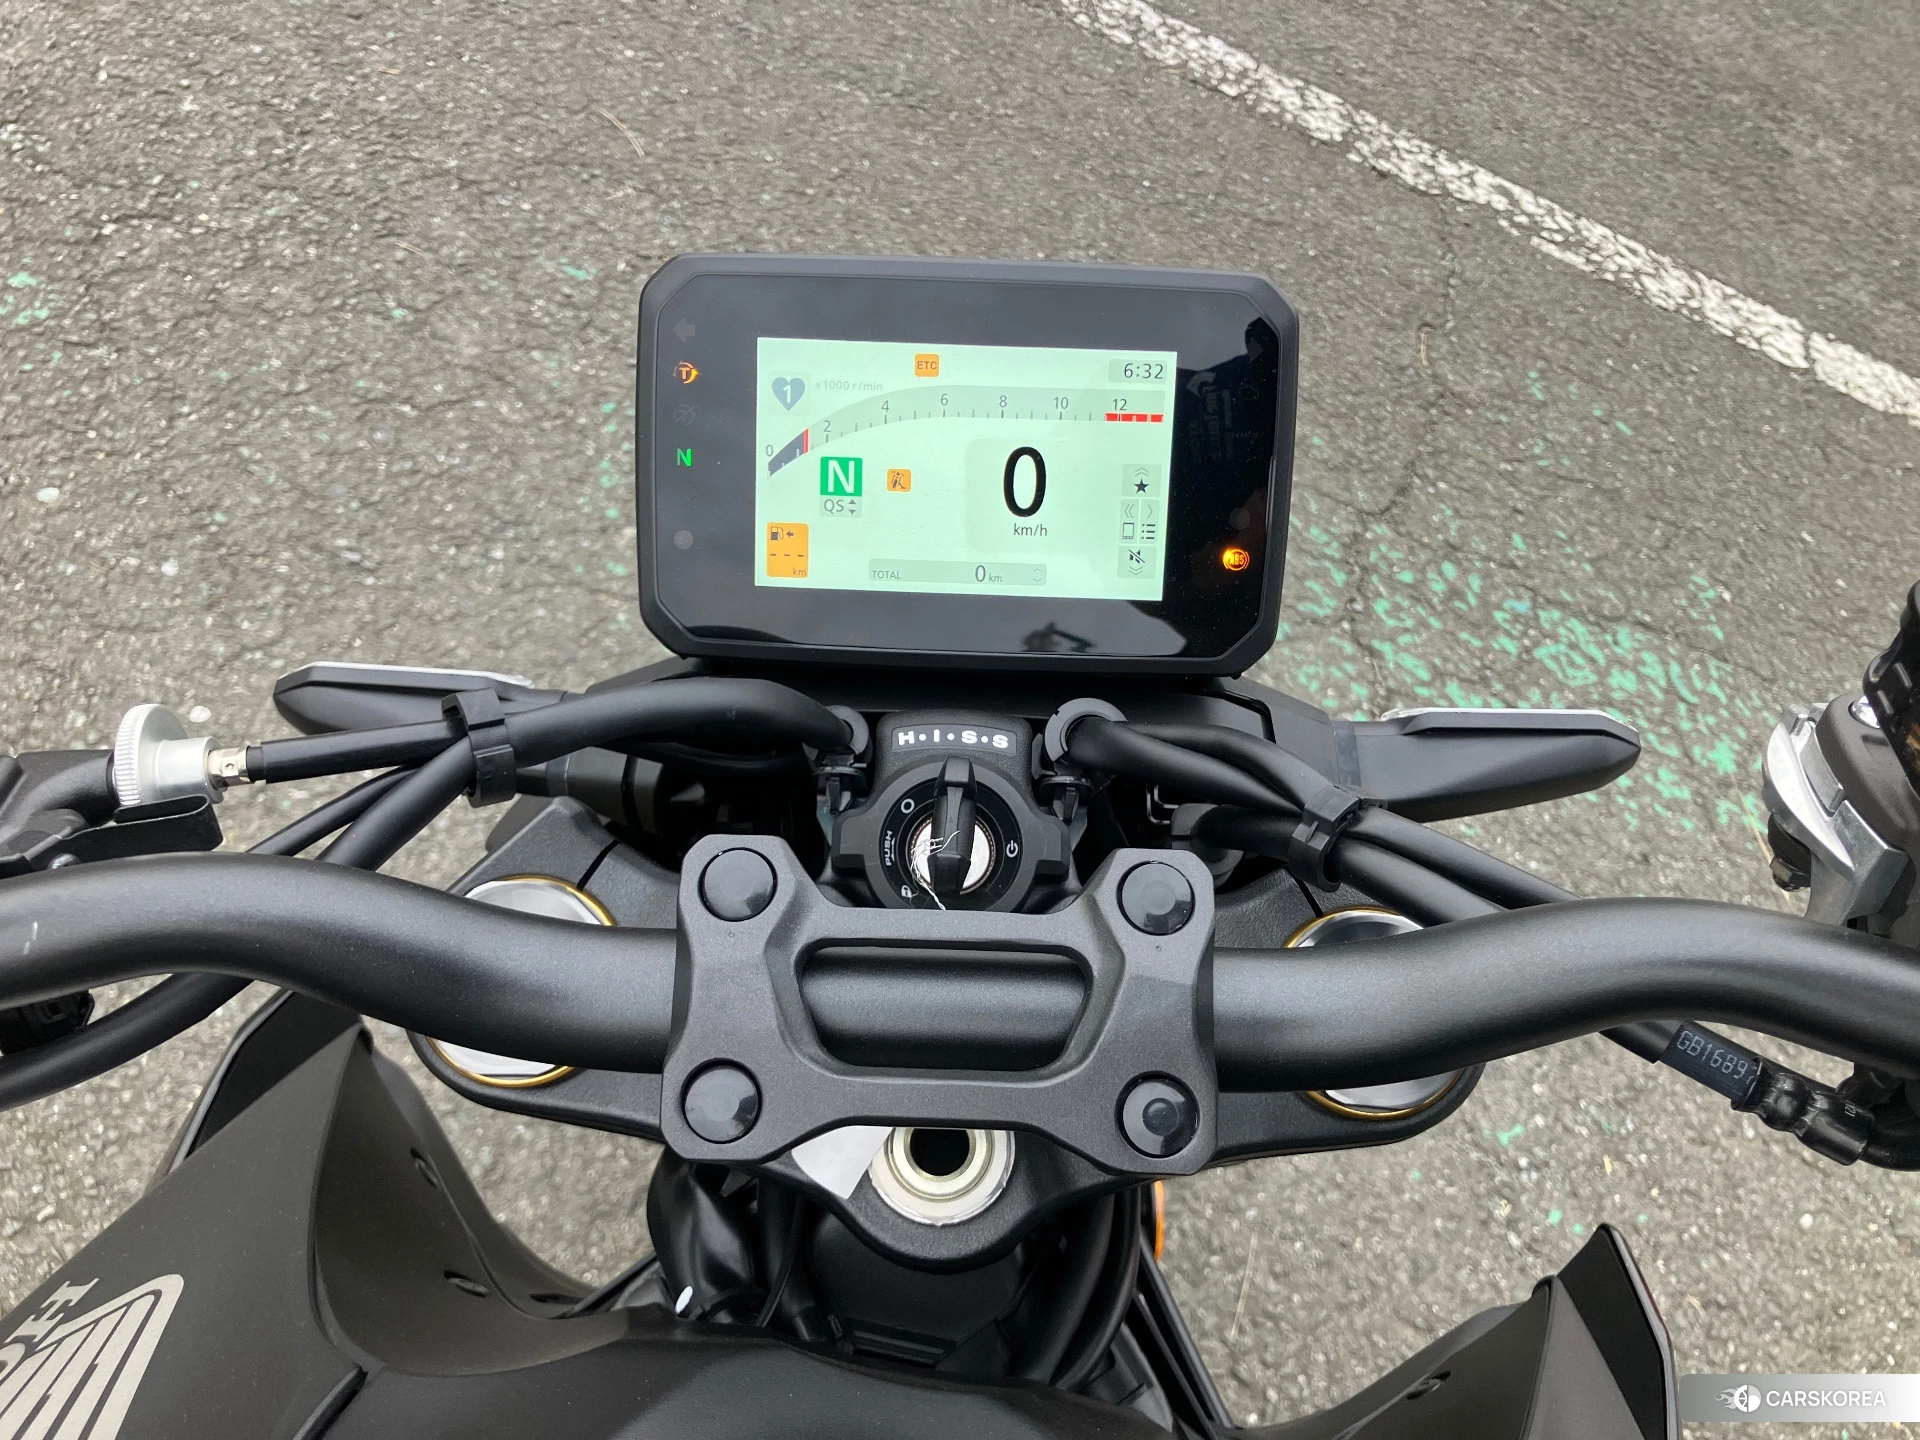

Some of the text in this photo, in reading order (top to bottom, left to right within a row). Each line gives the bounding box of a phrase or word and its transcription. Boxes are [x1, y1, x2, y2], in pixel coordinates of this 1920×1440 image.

[916, 360, 938, 370] ETC
[1123, 362, 1164, 380] 6:32
[852, 381, 883, 392] r/min
[782, 384, 792, 404] 1
[940, 393, 949, 406] 6
[881, 400, 890, 413] 4
[999, 395, 1008, 408] 8
[1053, 396, 1069, 410] 10
[1112, 398, 1127, 411] 12
[823, 419, 831, 433] 2
[676, 448, 692, 467] N
[765, 444, 774, 457] 0
[827, 459, 855, 494] N
[1003, 446, 1047, 518] 0
[823, 499, 844, 515] QS
[1013, 522, 1048, 537] km/h
[792, 567, 807, 577] km
[872, 564, 1003, 583] TOTAL 0 km
[884, 830, 892, 867] PUSH
